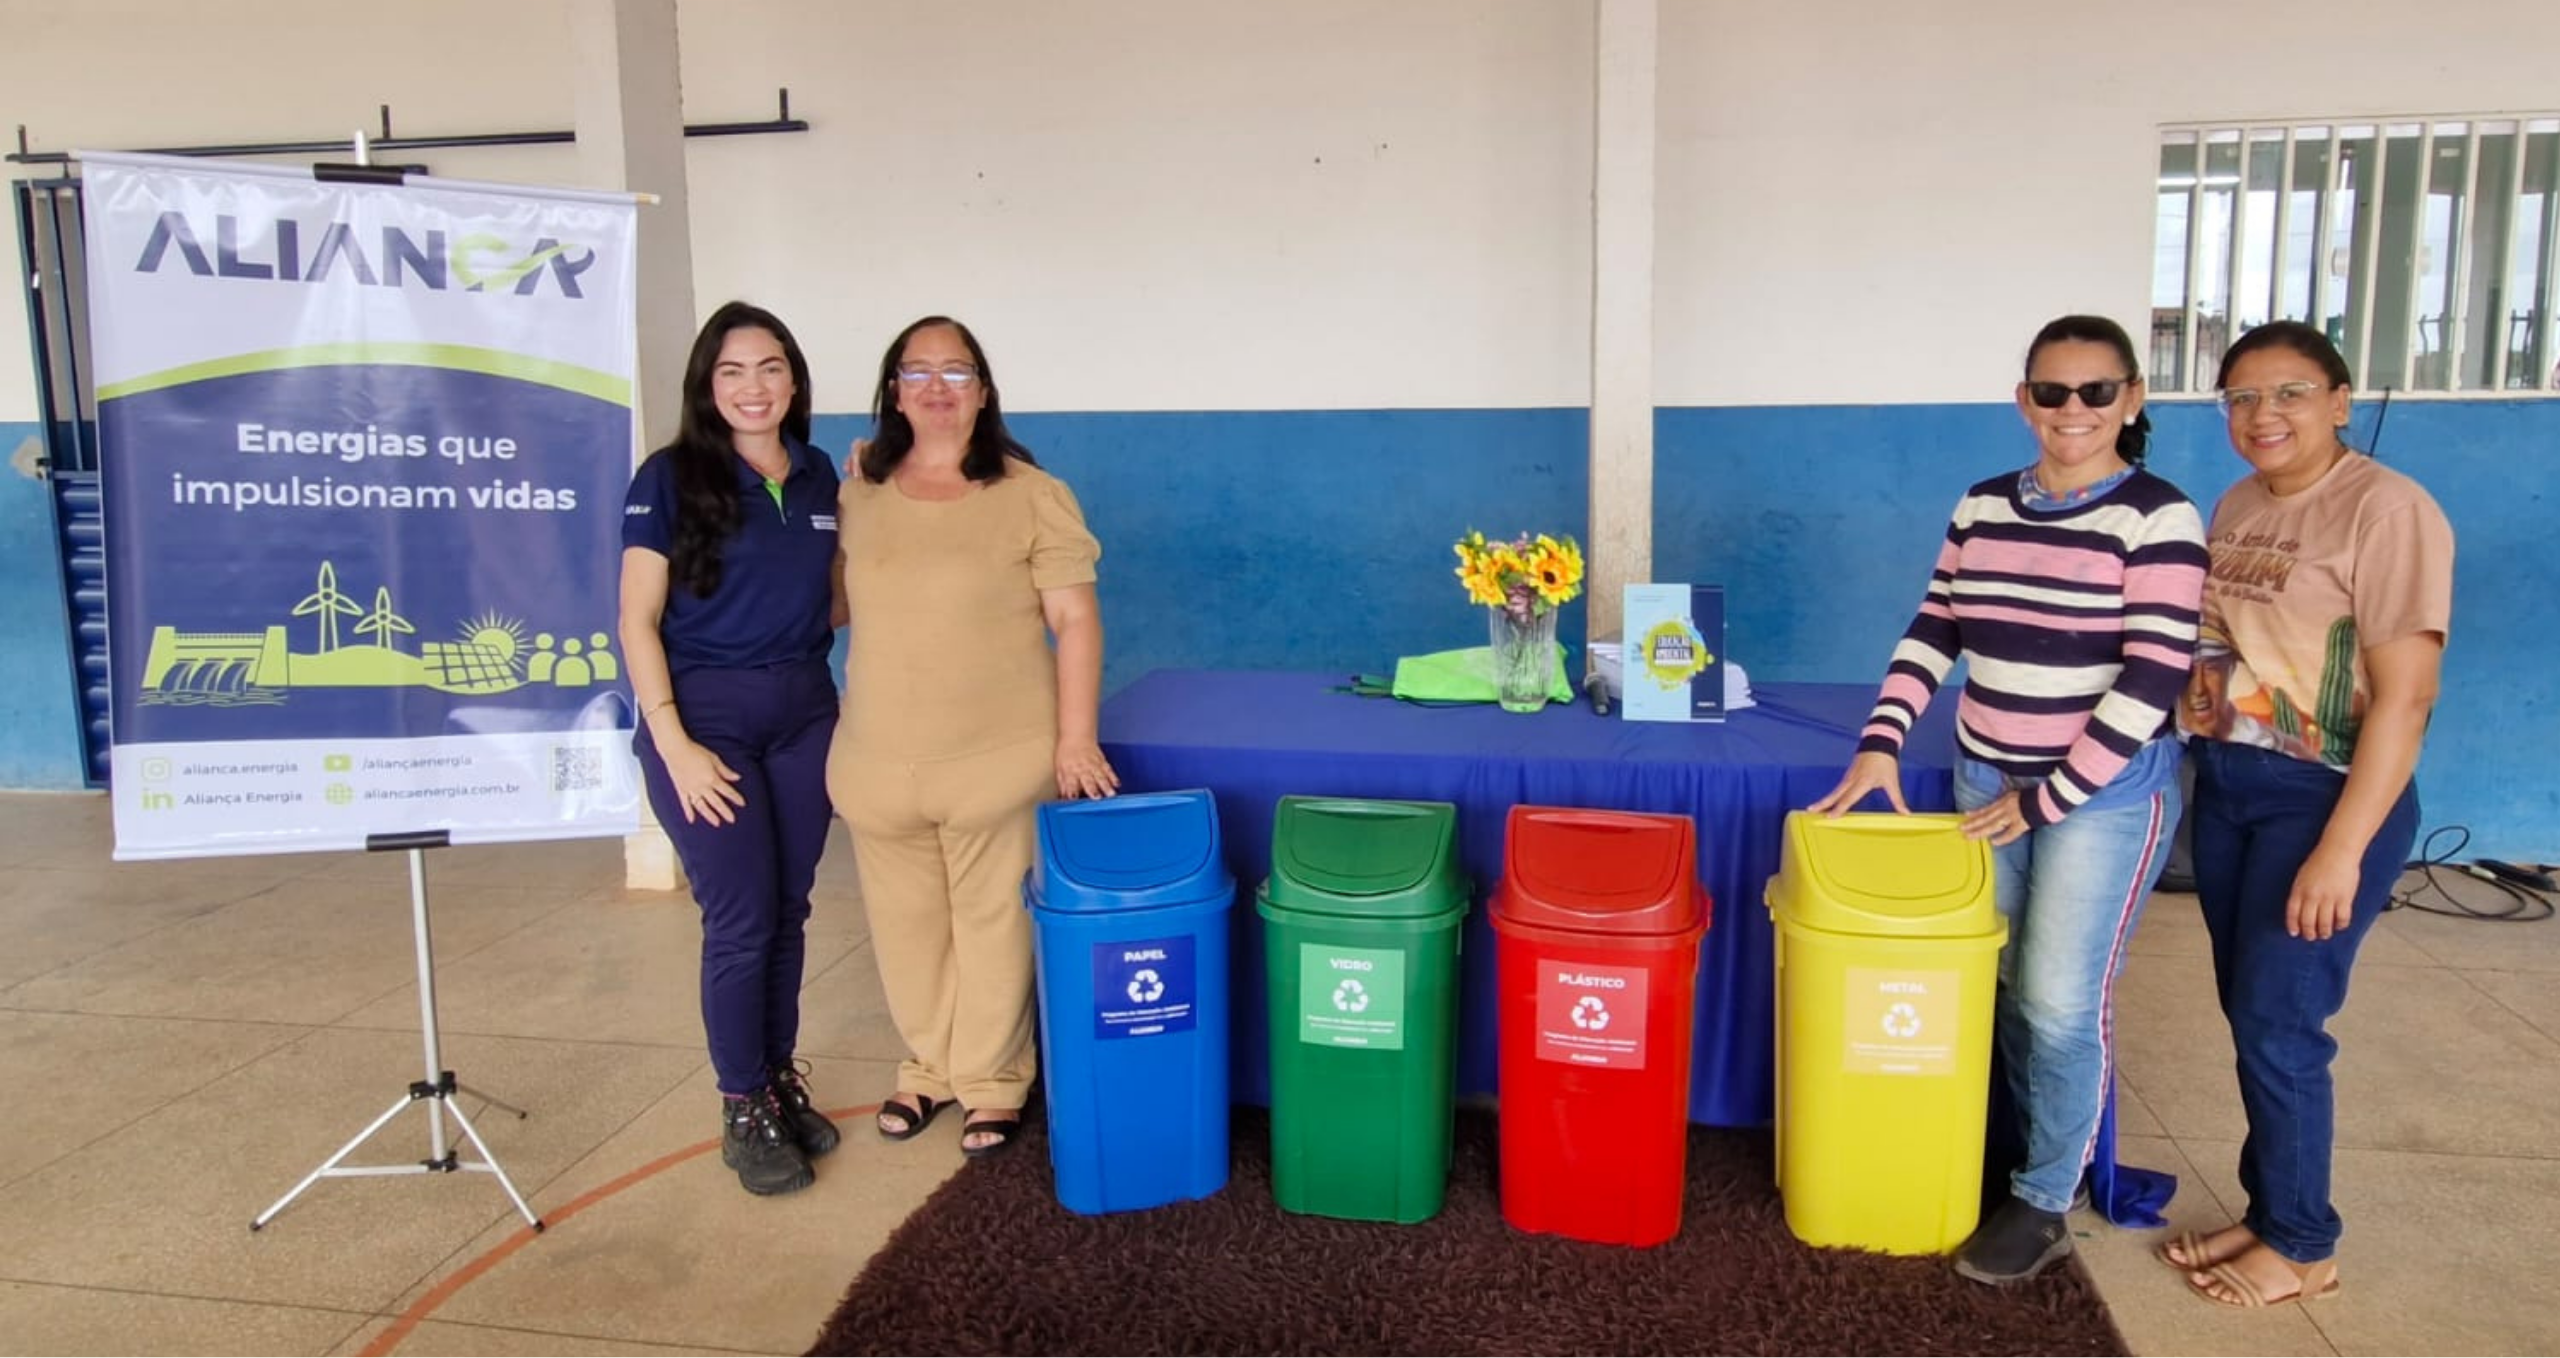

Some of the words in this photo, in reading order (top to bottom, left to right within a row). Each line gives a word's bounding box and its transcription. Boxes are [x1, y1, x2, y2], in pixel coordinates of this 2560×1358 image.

[237, 423, 427, 462] Energias
[440, 434, 517, 466] que
[173, 473, 457, 512] impulsionam
[467, 480, 577, 511] vidas
[184, 793, 242, 806] Aliança
[246, 790, 302, 804] Energia
[1123, 949, 1167, 962] PAPEL
[1329, 958, 1373, 971] VIDRO
[1558, 973, 1626, 989] PLÁSTICO
[1879, 981, 1928, 995] METAL
